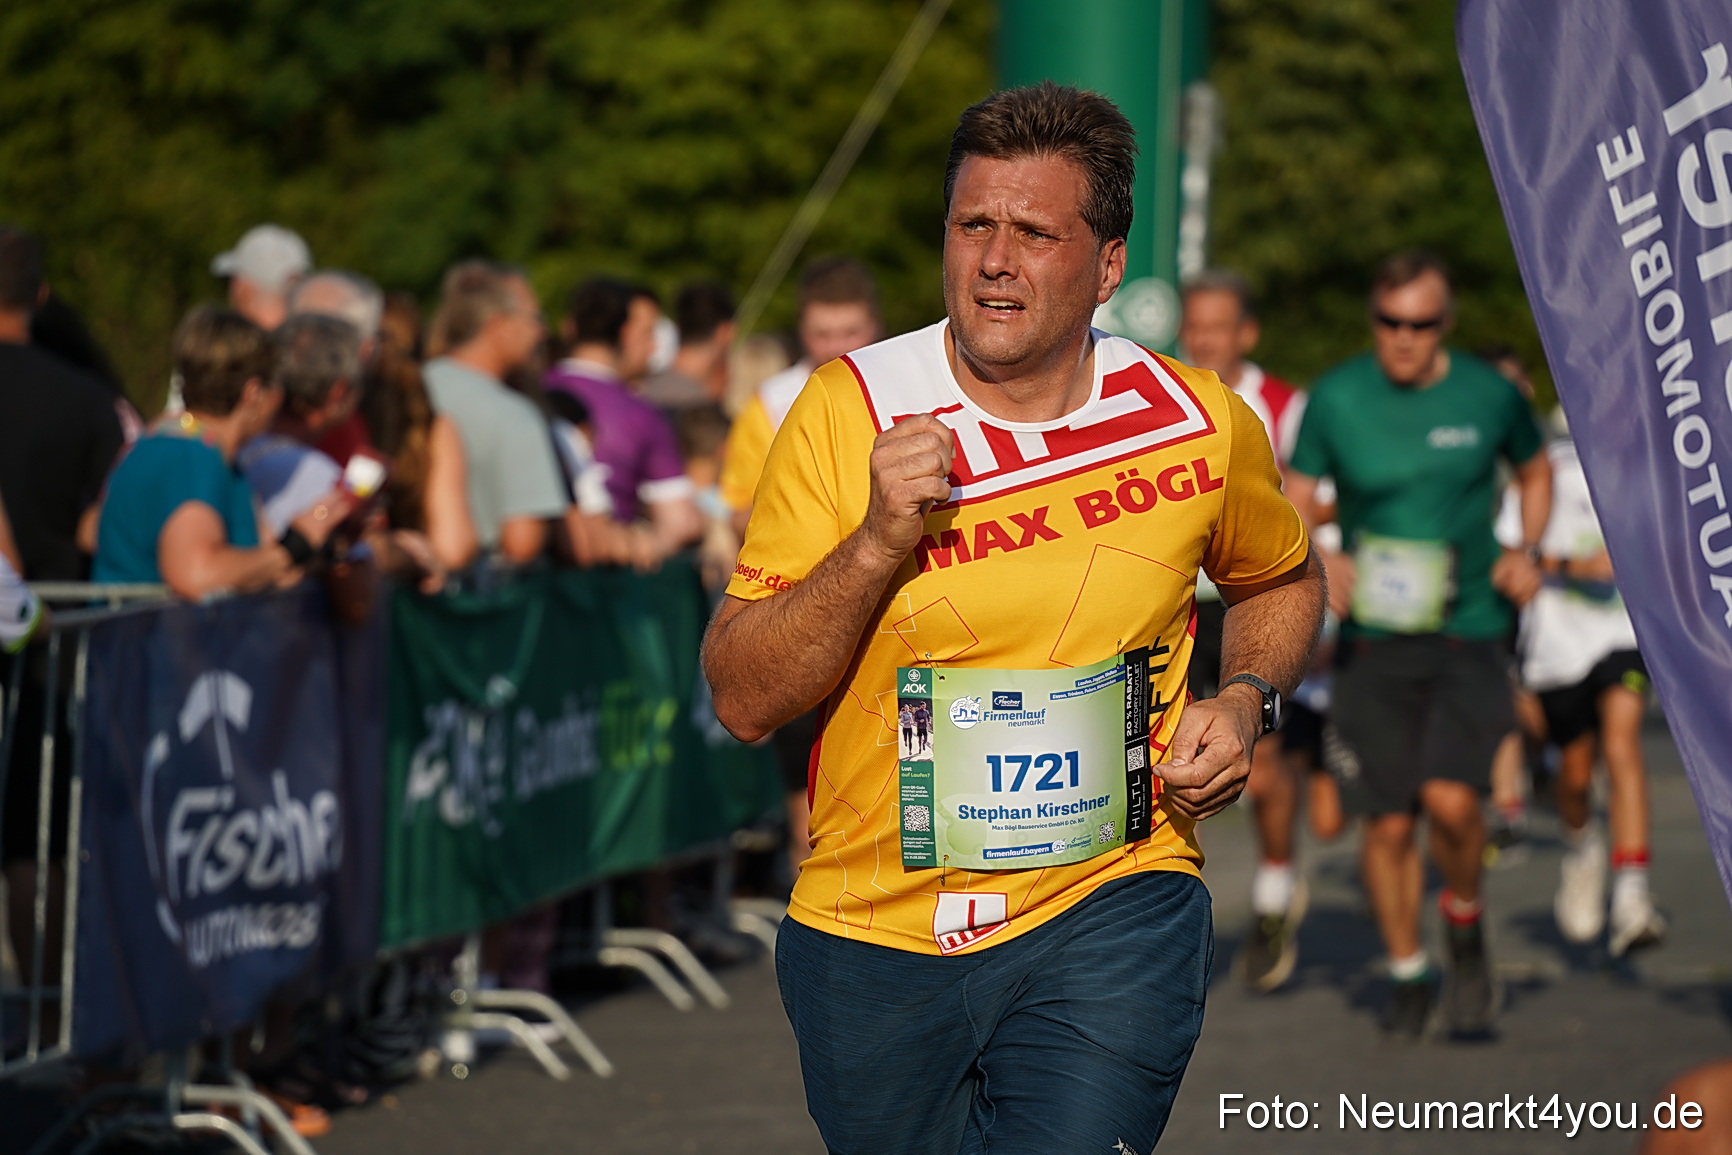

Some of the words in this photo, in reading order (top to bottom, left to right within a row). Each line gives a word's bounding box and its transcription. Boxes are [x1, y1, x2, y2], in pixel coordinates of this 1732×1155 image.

[912, 505, 1063, 573] MAX
[1072, 457, 1224, 530] BÖGL
[902, 683, 927, 694] AOK
[983, 708, 1046, 721] Firmenlauf
[1126, 711, 1132, 720] %
[1007, 719, 1045, 728] neumarkt
[1126, 721, 1133, 737] 20
[986, 750, 1079, 792] 1721
[958, 804, 1032, 823] Stephan
[1037, 794, 1111, 818] Kirschner
[1131, 774, 1141, 830] HILTL
[1004, 824, 1017, 832] Bögl
[1018, 822, 1047, 830] Bauservice
[986, 846, 1049, 858] firmenlauf.bayern
